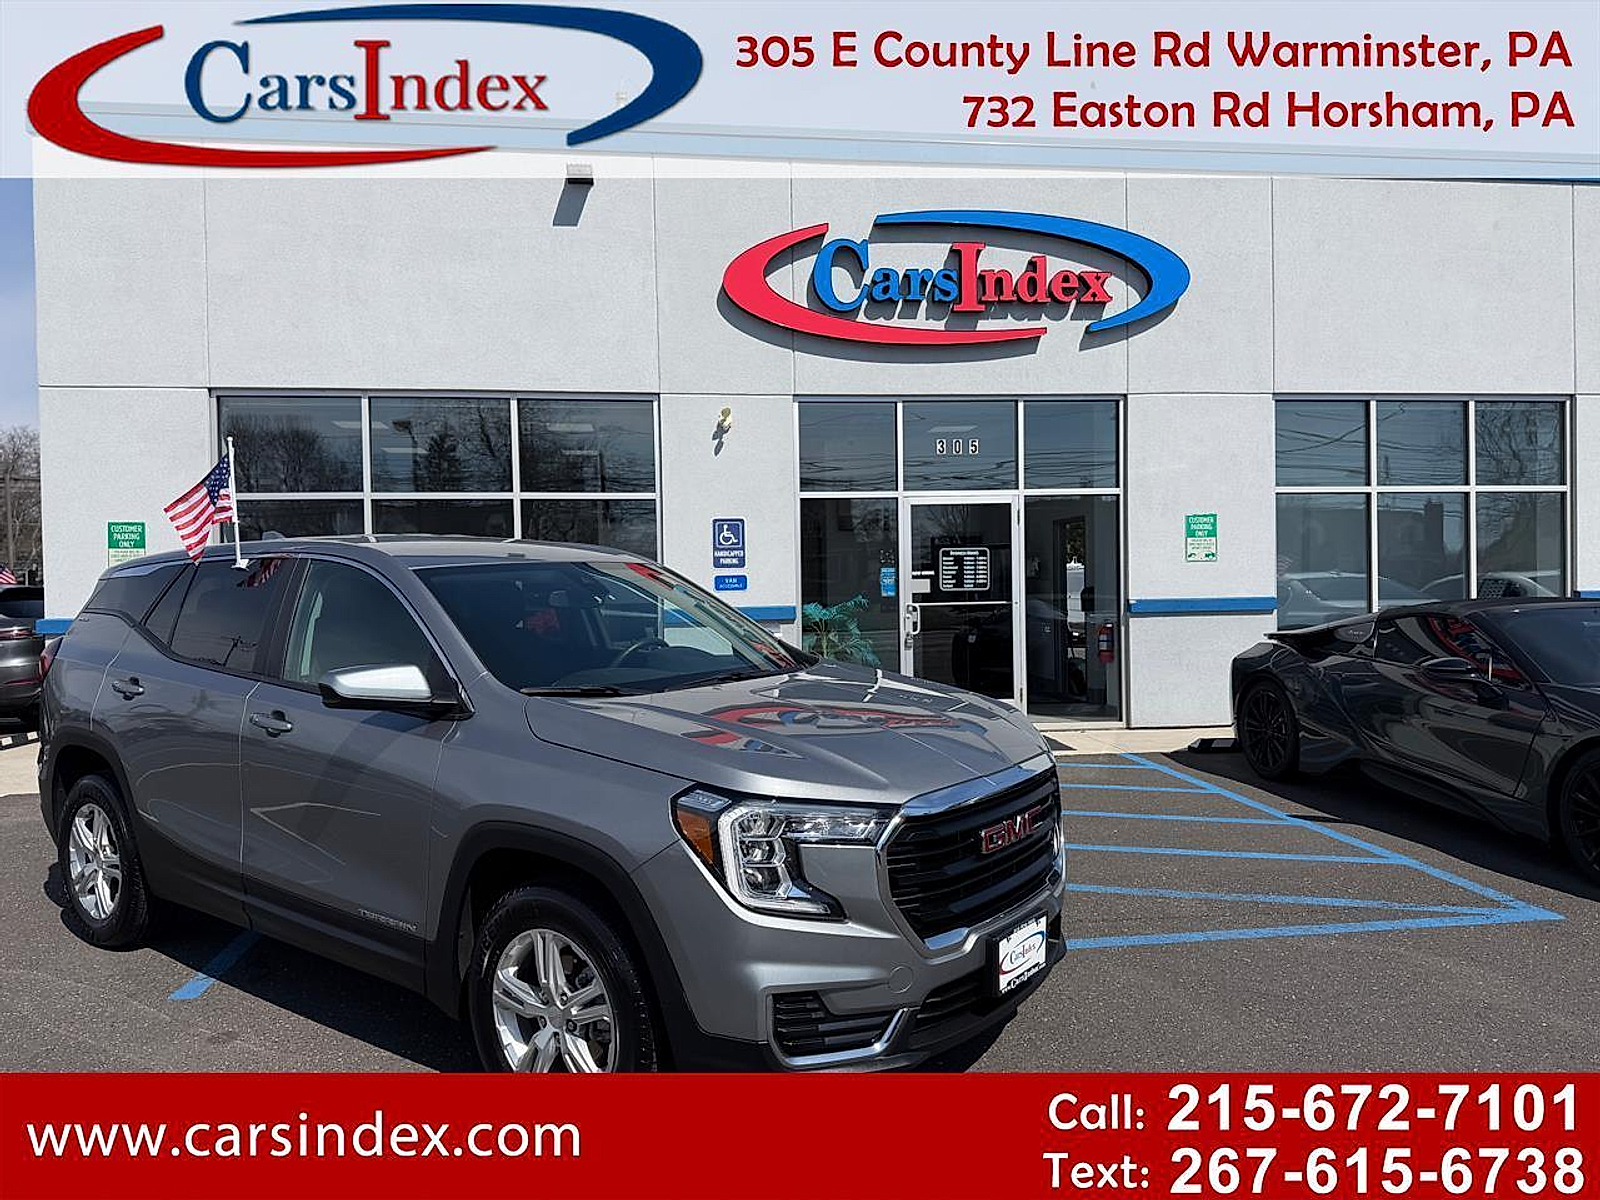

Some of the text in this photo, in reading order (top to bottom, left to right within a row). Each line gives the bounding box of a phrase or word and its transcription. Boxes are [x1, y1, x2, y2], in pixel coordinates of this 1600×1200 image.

[812, 239, 1114, 313] CarsIndex
[937, 439, 978, 454] 305
[110, 524, 143, 533] CUSTOMER
[981, 805, 1043, 853] GMC
